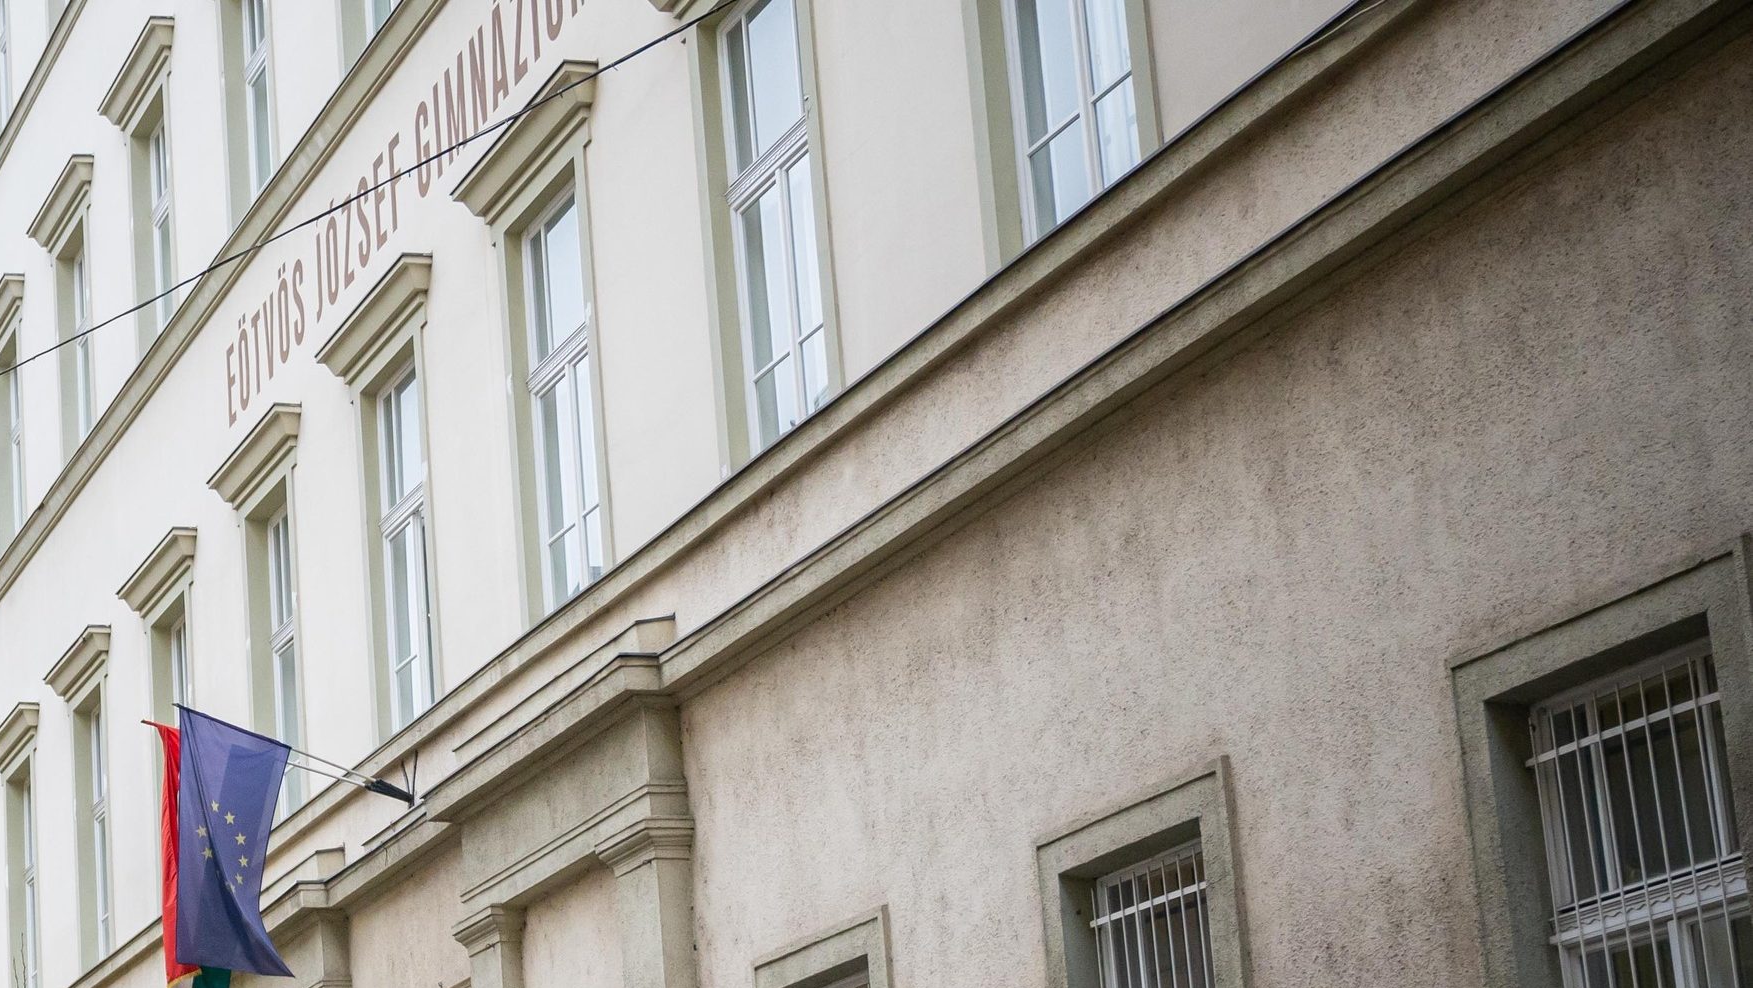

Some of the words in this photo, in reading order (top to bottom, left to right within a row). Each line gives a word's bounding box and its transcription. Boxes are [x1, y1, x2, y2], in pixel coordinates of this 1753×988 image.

[226, 258, 305, 428] EÖTVÖS
[316, 131, 402, 324] JÓZSEF
[415, 0, 584, 198] GIMNÁZI
